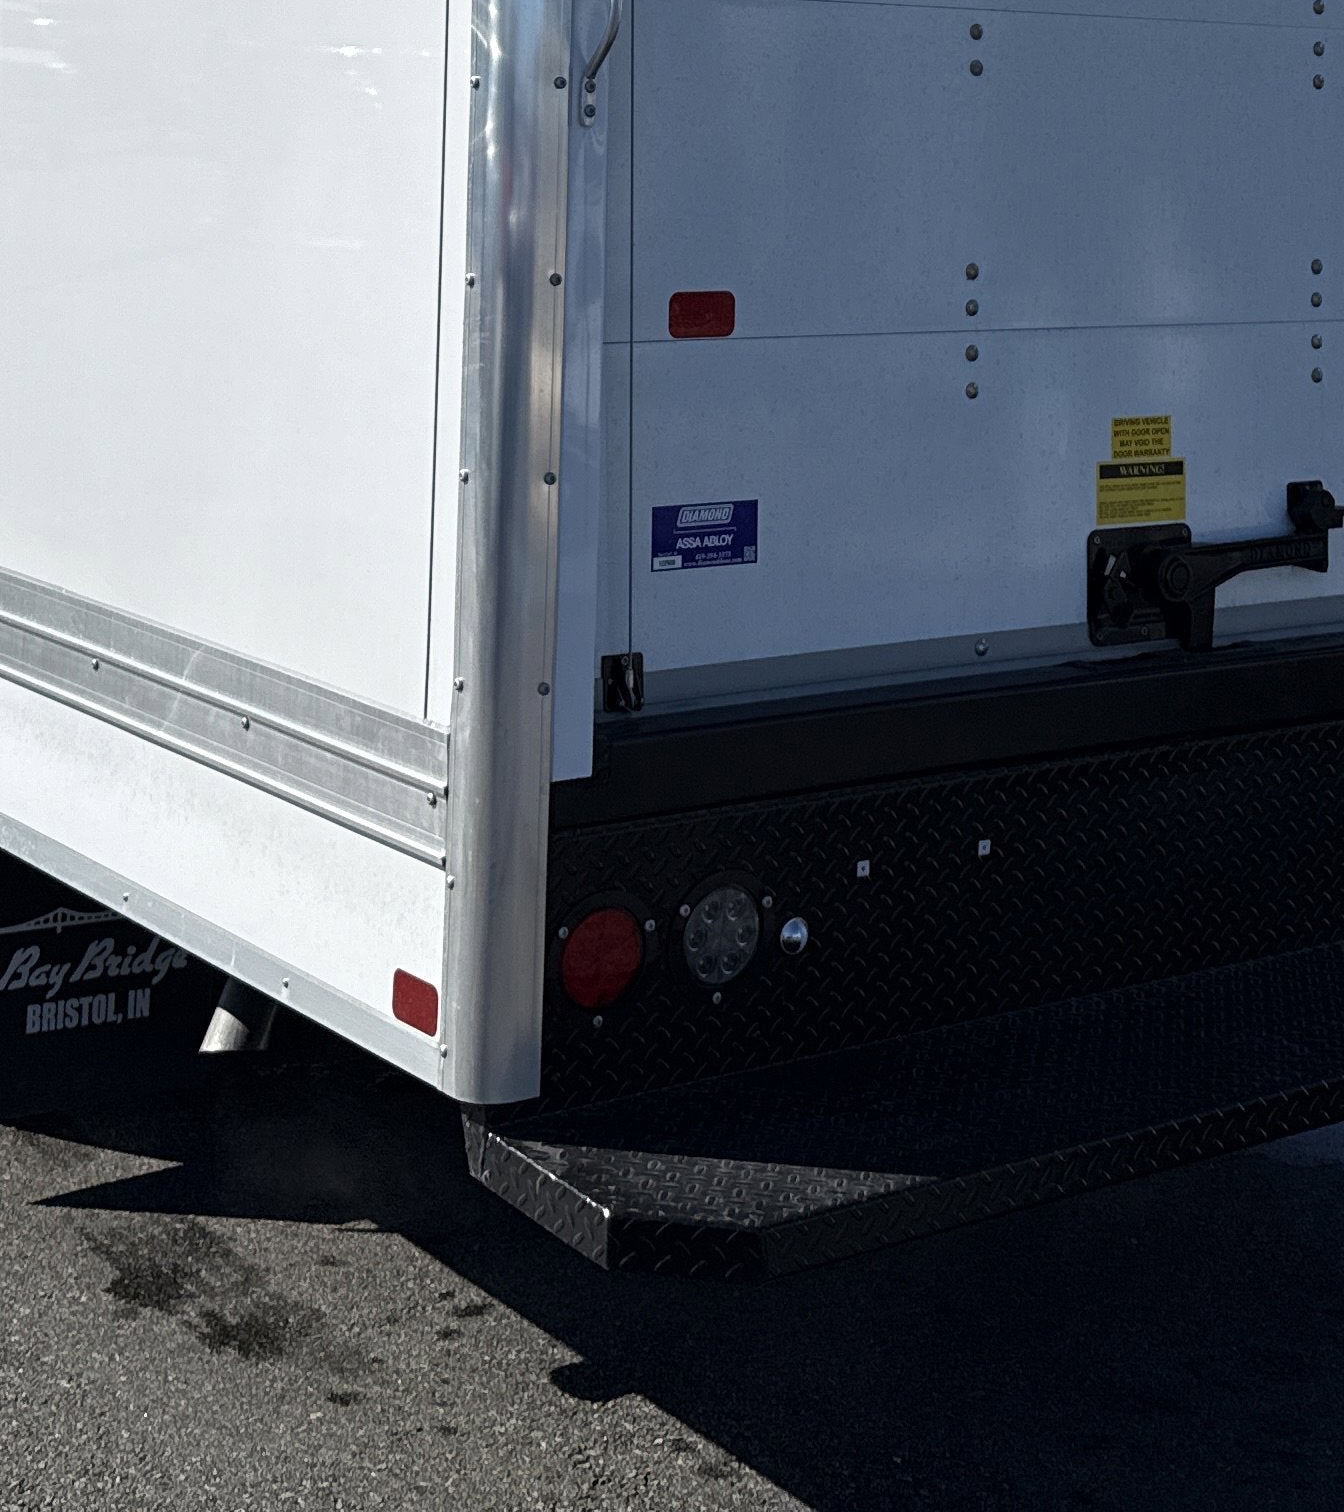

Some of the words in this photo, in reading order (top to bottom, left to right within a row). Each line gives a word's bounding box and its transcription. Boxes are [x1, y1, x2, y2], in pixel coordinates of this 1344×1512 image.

[1142, 416, 1169, 426] VEHICLE
[1119, 463, 1165, 476] WARNING!
[681, 507, 730, 523] DIAMOND
[676, 536, 702, 549] ASSA
[702, 534, 734, 548] ABLOY
[69, 937, 188, 985] Bridge
[25, 992, 123, 1035] BRISTOL,
[127, 987, 151, 1020] IN
